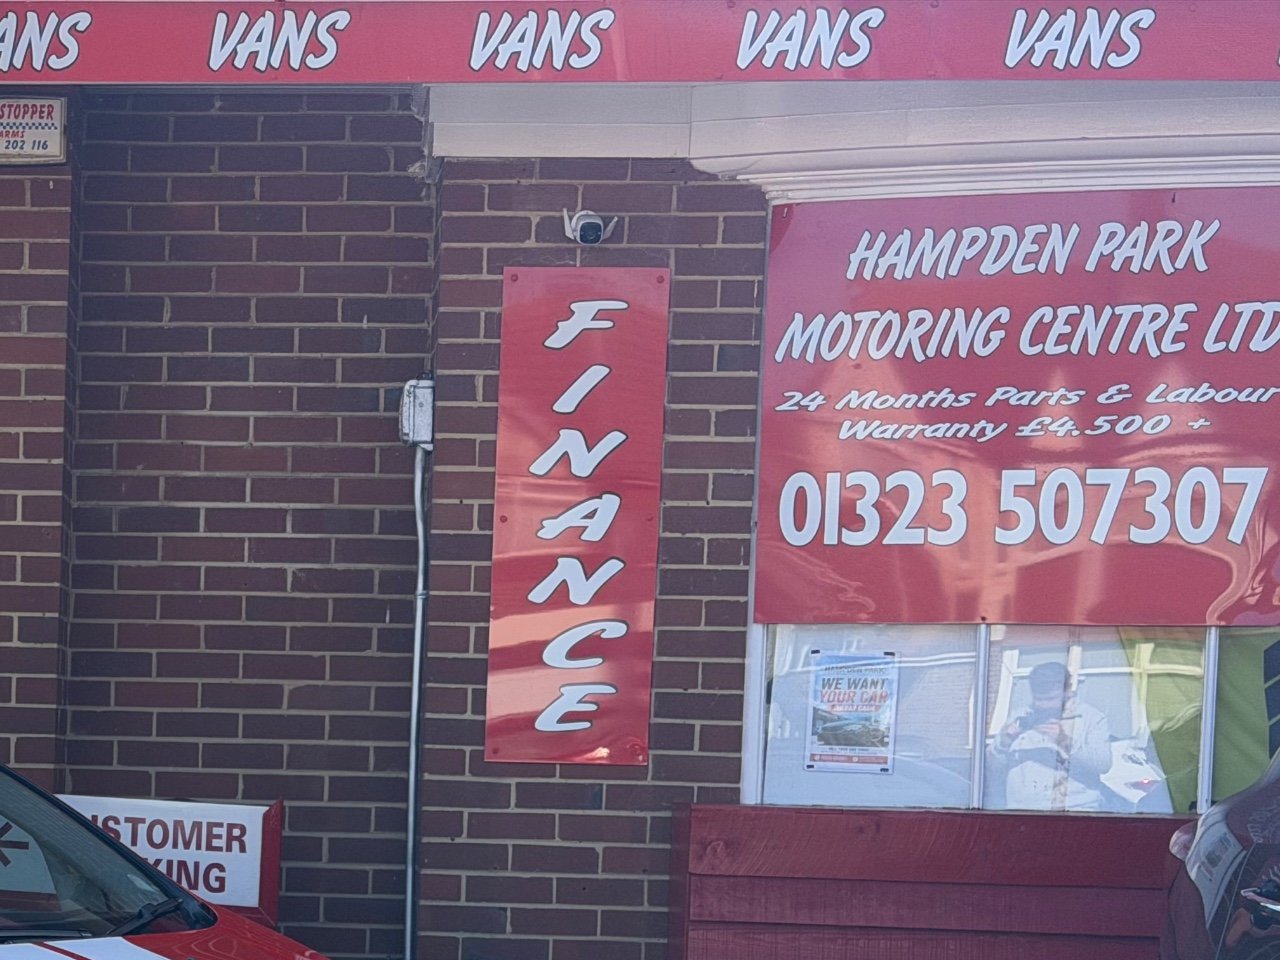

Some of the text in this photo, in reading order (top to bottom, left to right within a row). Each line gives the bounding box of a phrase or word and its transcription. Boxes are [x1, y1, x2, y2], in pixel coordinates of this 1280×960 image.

[208, 10, 350, 72] VANS
[469, 9, 615, 72] VANS
[736, 8, 885, 70] VANS
[1004, 8, 1155, 70] VANS
[5, 140, 25, 150] 202
[31, 140, 49, 150] 116
[846, 219, 1220, 281] HAMPDEN PARK
[774, 301, 1280, 363] MOTORING CENTRE LTD
[774, 382, 1280, 412] 24 Months Parts & Labour
[837, 417, 1008, 442] Warranty
[526, 299, 629, 733] FINANCE
[778, 465, 1270, 547] 01323 507307
[820, 690, 856, 703] YOUR
[821, 677, 888, 690] WE WANT
